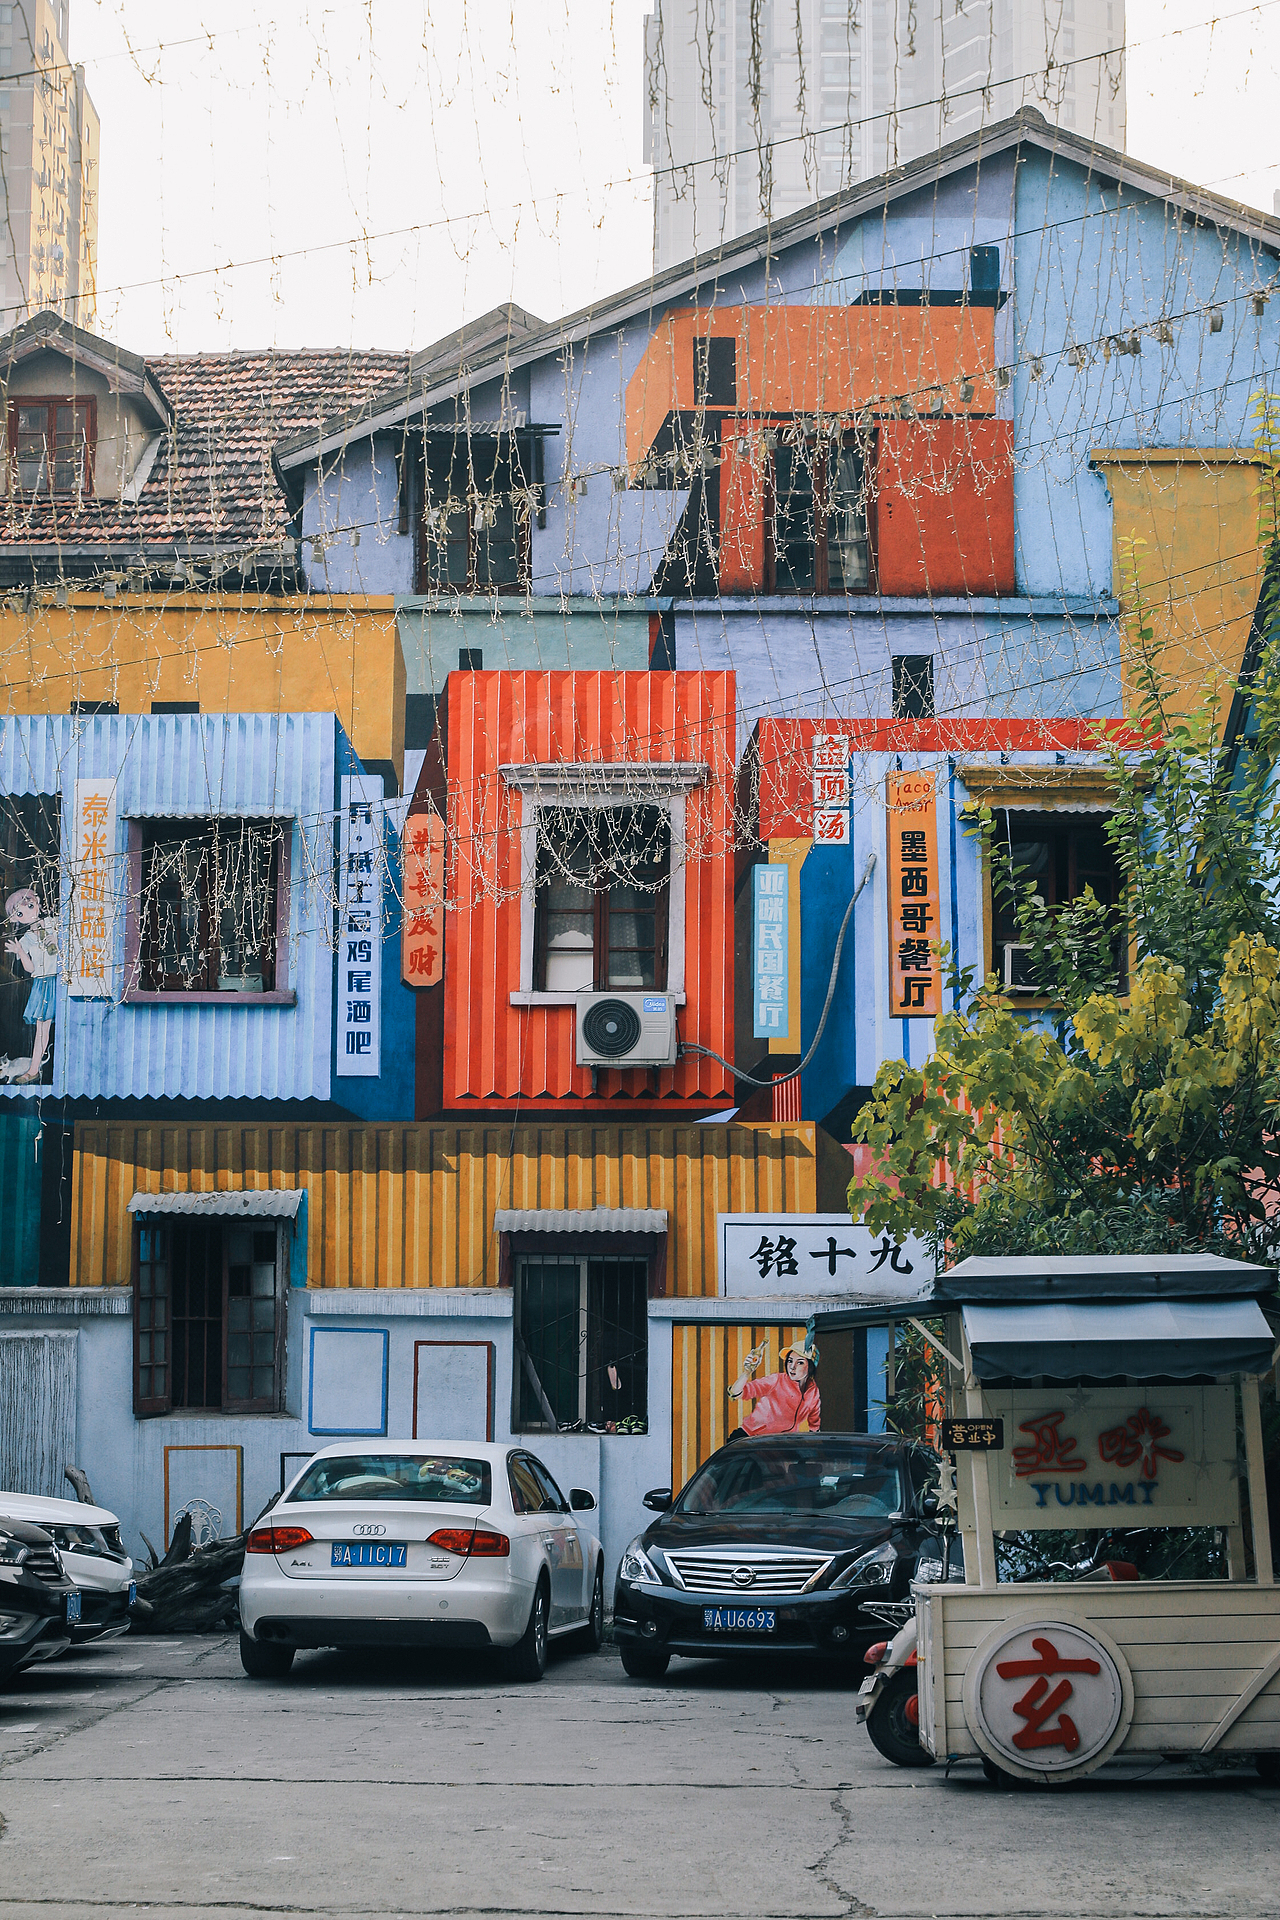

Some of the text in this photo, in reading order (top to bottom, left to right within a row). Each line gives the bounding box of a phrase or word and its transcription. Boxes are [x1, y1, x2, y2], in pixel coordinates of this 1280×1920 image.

[80, 793, 108, 978] 泰米甜品店
[407, 828, 441, 976] 恭喜发财
[758, 870, 785, 1027] 亚咪民国餐厅
[898, 831, 933, 1007] 墨西哥餐厅
[749, 1235, 914, 1278] 铭十九
[948, 1424, 997, 1446] 营业中
[1031, 1482, 1159, 1506] YUMMY
[996, 1637, 1101, 1752] 玄
